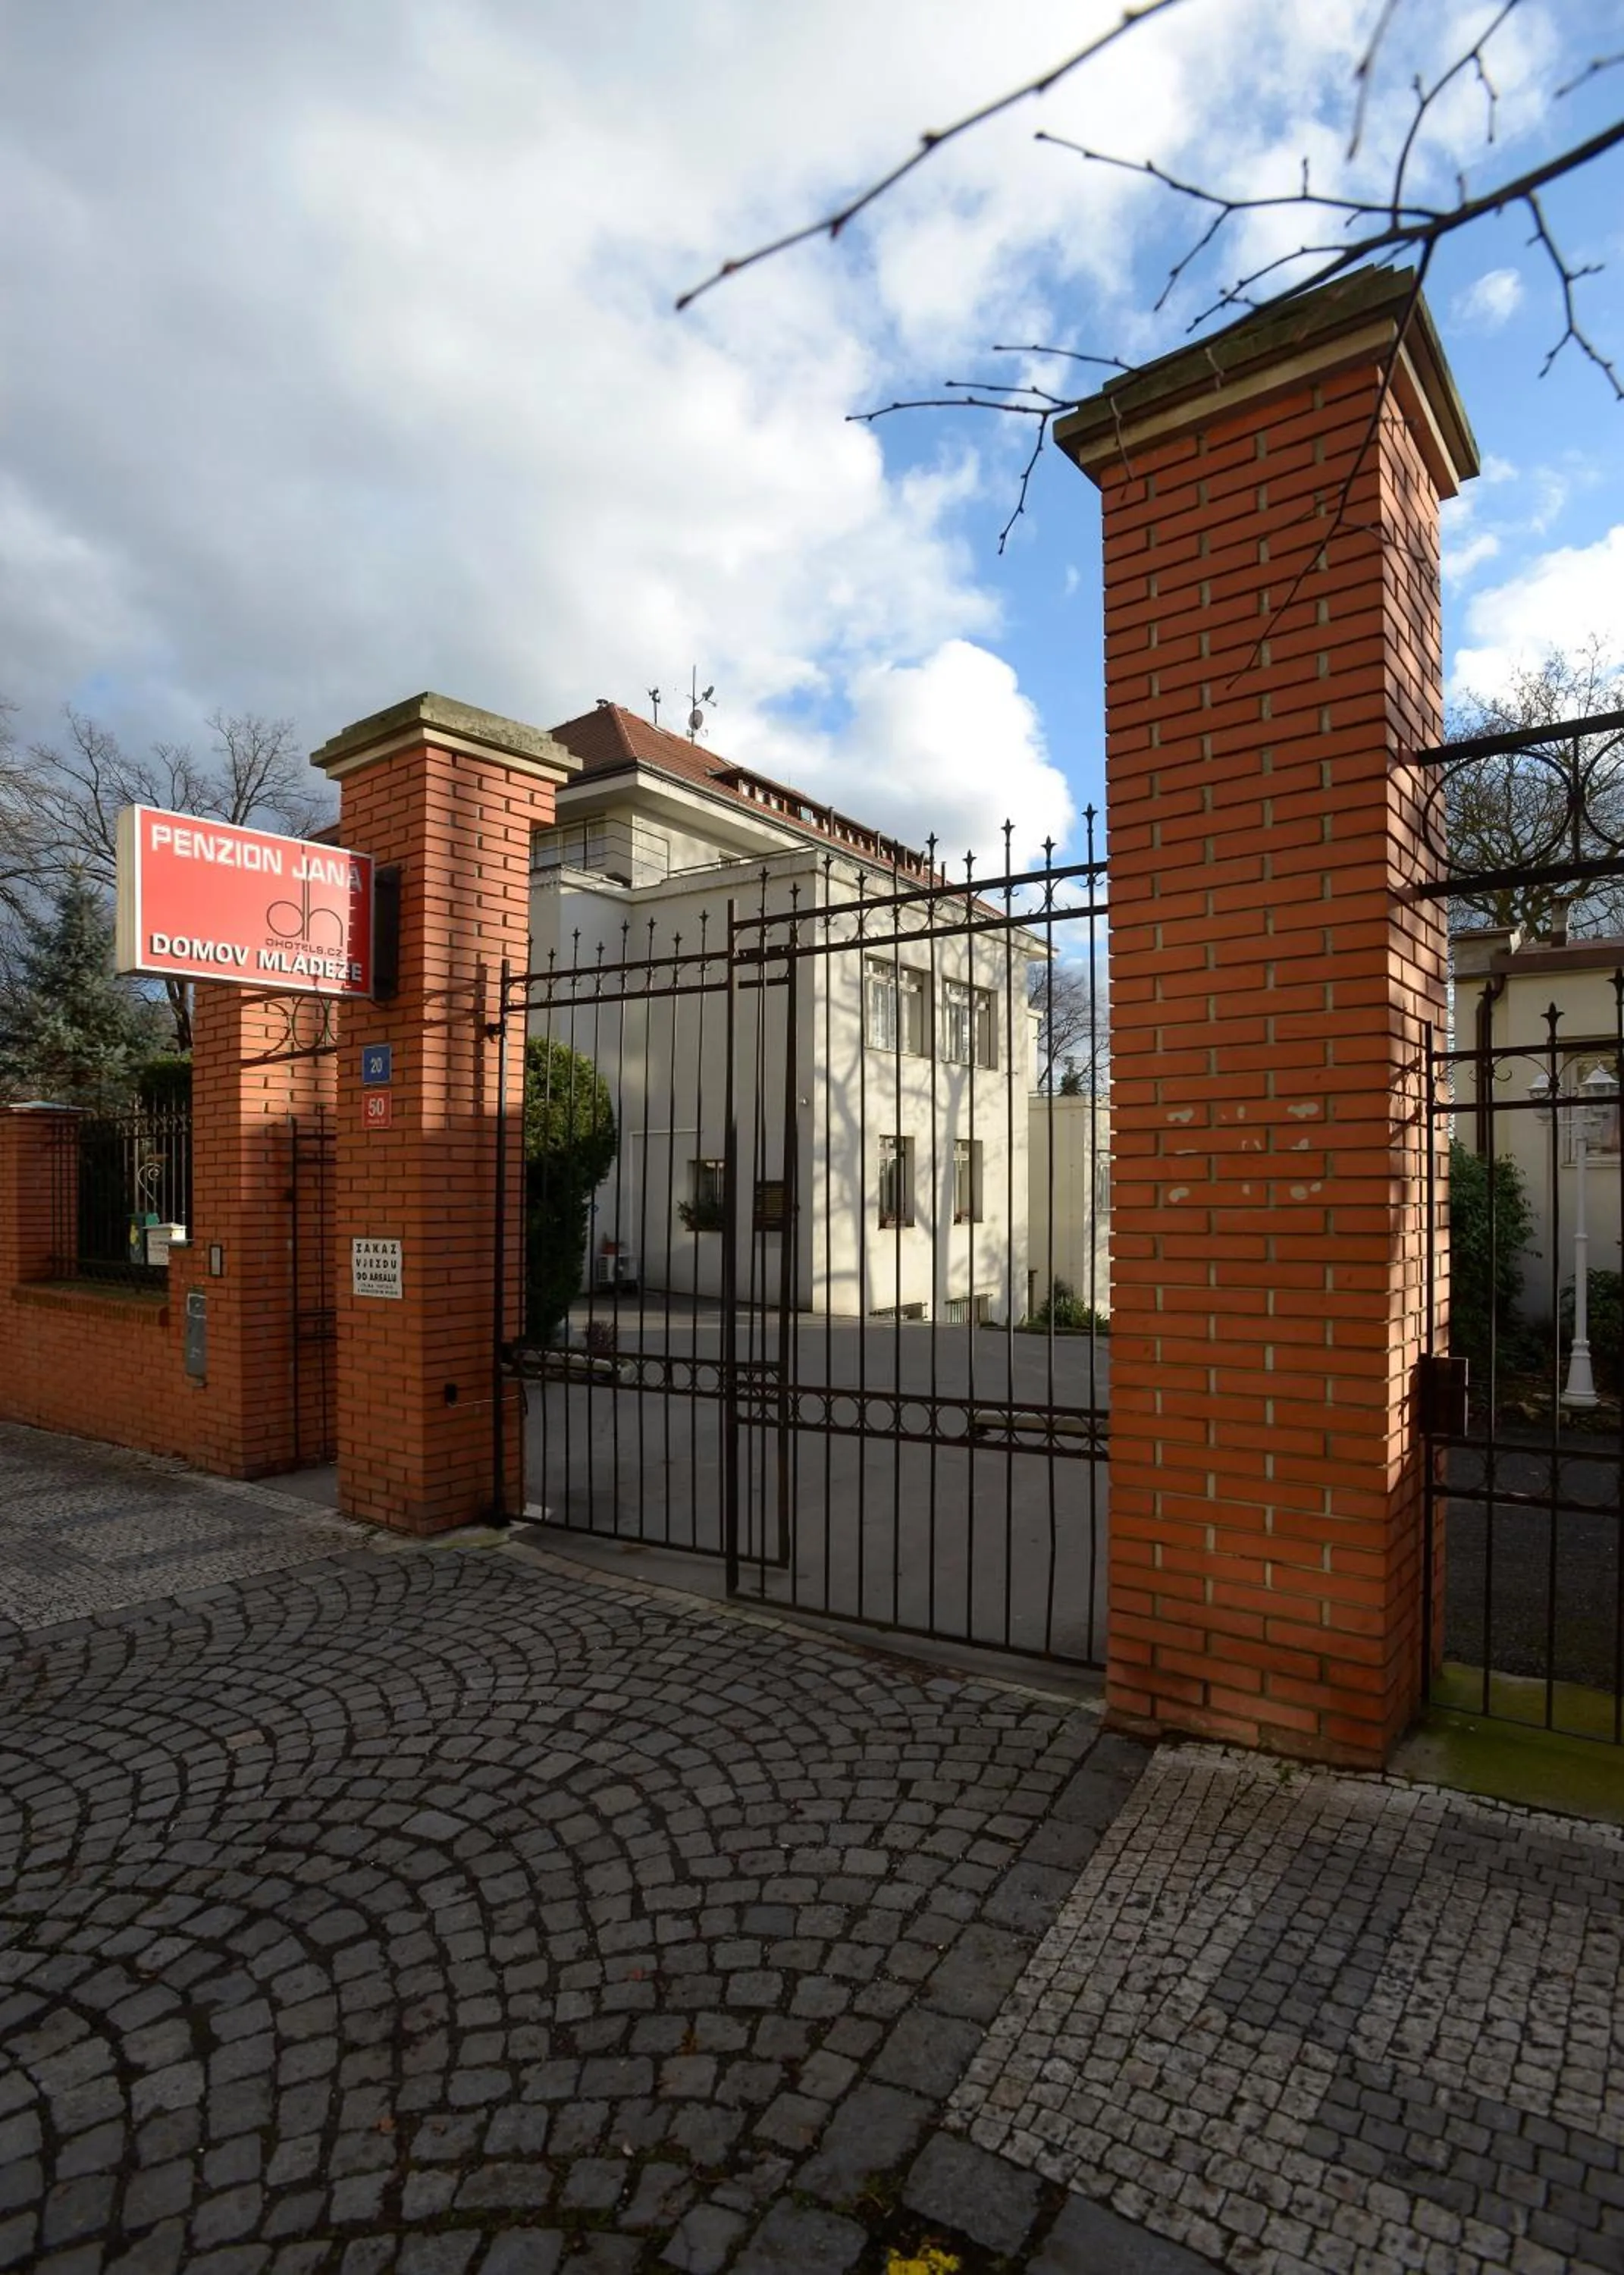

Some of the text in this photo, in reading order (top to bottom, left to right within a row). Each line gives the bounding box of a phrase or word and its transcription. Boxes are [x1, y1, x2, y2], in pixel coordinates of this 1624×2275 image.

[151, 824, 362, 893] PENZION JANA
[150, 932, 249, 967] DOMOV
[370, 1056, 383, 1074] 20
[368, 1097, 384, 1116] 50
[356, 1258, 397, 1269] VJEZDU
[356, 1272, 367, 1281] DO
